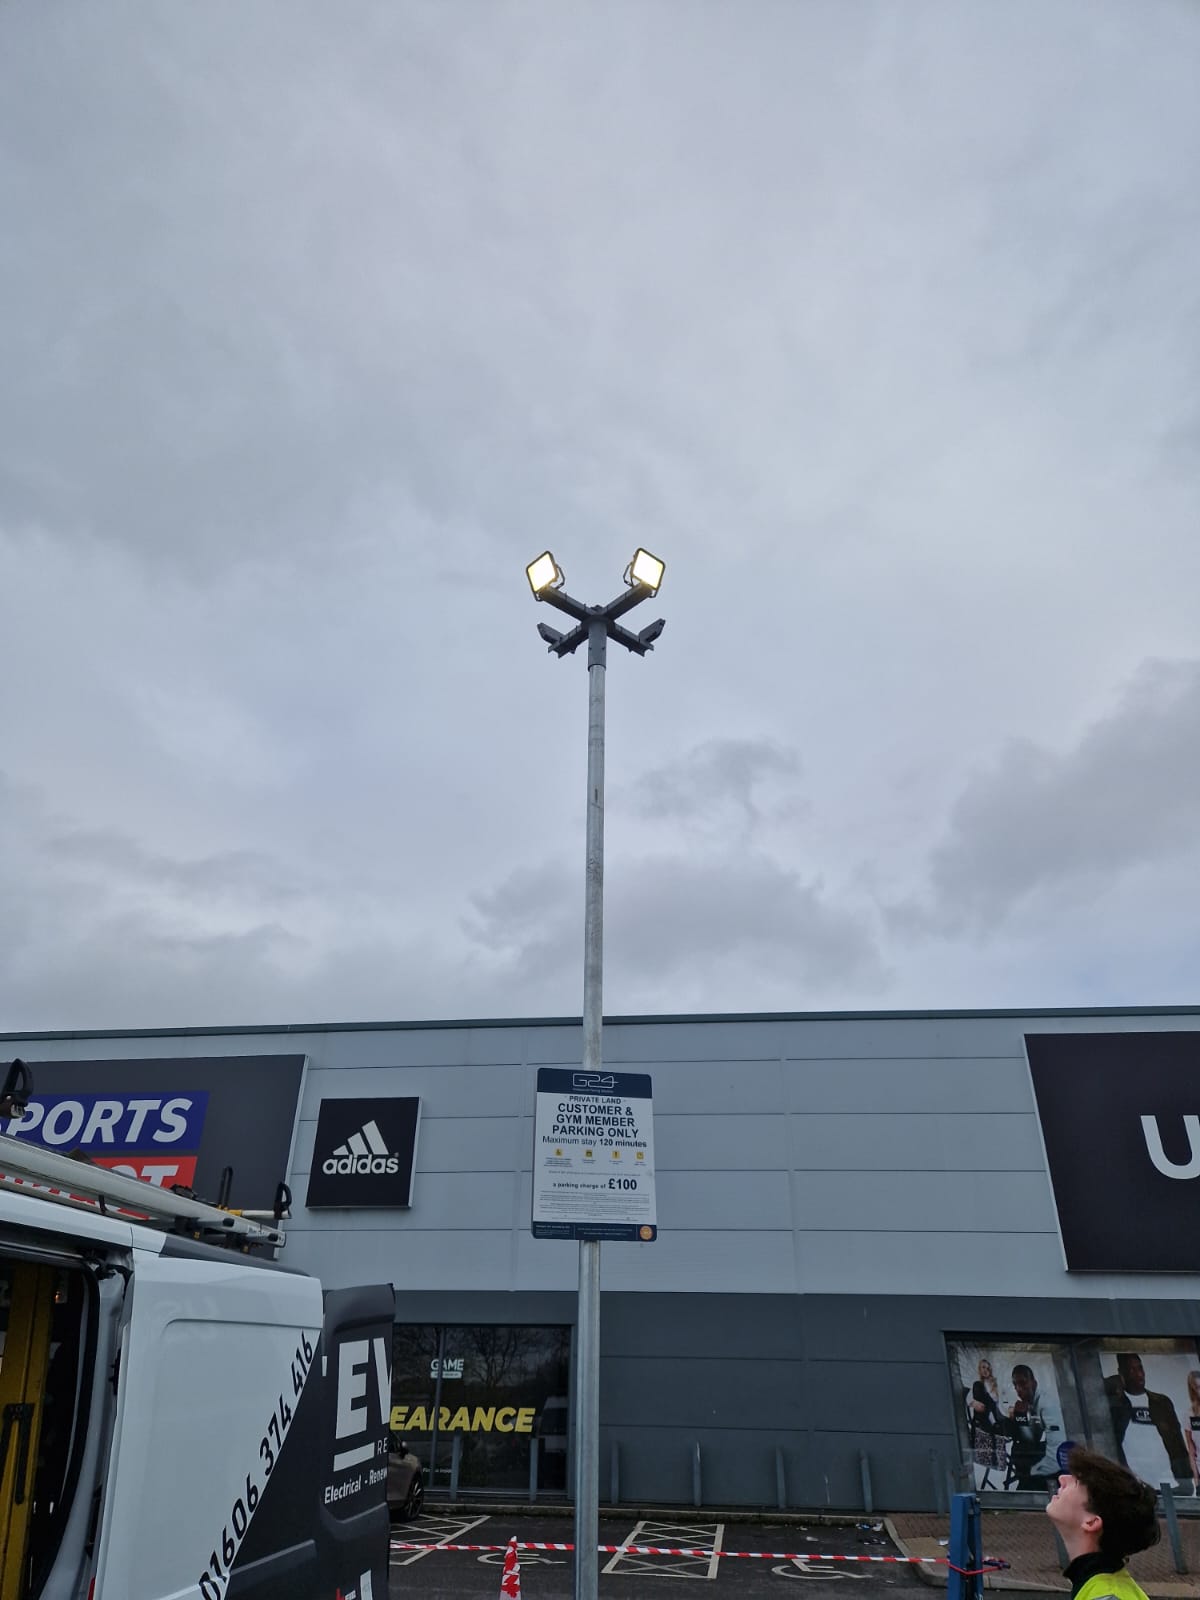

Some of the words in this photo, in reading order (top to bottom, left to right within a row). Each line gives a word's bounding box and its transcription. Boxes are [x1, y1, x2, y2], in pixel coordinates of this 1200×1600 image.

[572, 1073, 619, 1089] G24
[569, 1095, 600, 1104] PRIVATE
[601, 1097, 622, 1105] LAND
[558, 1103, 622, 1116] CUSTOMER
[625, 1106, 633, 1116] &
[0, 1098, 193, 1145] PORTS
[556, 1114, 582, 1125] GYM
[585, 1115, 635, 1127] MEMBER
[552, 1125, 604, 1137] PARKING
[607, 1127, 639, 1139] ONLY
[542, 1136, 579, 1145] Maximum
[581, 1138, 598, 1147] stay
[600, 1138, 613, 1147] 120
[615, 1139, 647, 1148] minutes
[322, 1154, 399, 1175] adidas
[608, 1178, 638, 1191] £100
[199, 1472, 259, 1600] 01606
[259, 1392, 292, 1477] 374
[290, 1328, 313, 1397] 416
[324, 1475, 362, 1504] Electrical
